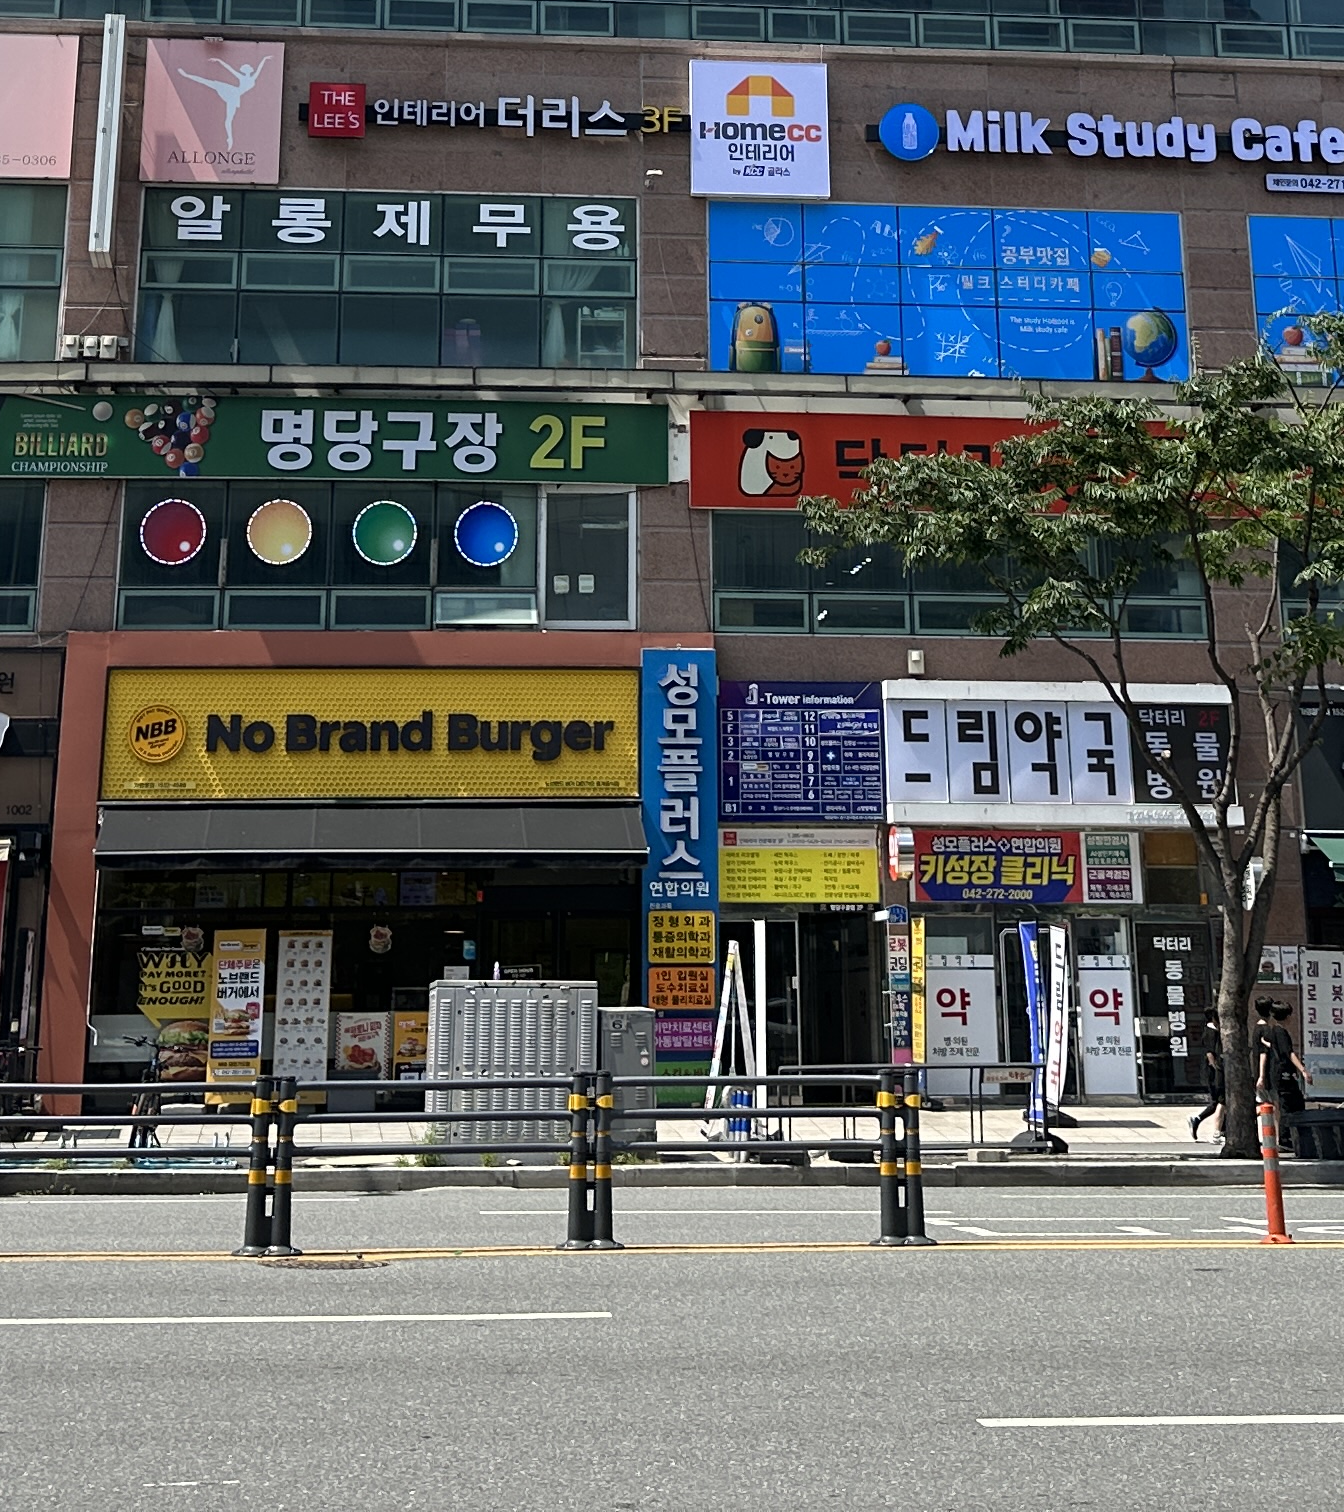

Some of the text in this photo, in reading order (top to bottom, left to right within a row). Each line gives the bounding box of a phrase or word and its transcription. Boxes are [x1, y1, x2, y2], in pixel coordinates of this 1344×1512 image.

[320, 90, 356, 106] THE
[314, 111, 361, 130] LEE'S
[374, 94, 683, 138] 인테리어 더리스 3F
[946, 109, 1052, 155] Milk
[1066, 112, 1217, 163] Study
[167, 149, 256, 167] ALLONGE
[728, 142, 795, 163] 인테리어
[1000, 245, 1071, 266] 공부맛집
[14, 431, 109, 457] BILLIARD
[260, 408, 607, 474] 명당구장 2F
[11, 461, 109, 473] CHAMPIONSHIP
[1138, 708, 1186, 728] 닥터리
[135, 710, 615, 762] NBB No Brand Burger
[902, 709, 1117, 796] 드림약국
[657, 662, 704, 880] 성모플러스
[6, 803, 33, 816] 1002
[931, 836, 1062, 854] 성모플러스 연합의원
[920, 855, 997, 885] 키성장
[1001, 855, 1076, 887] 클리닉
[649, 881, 710, 898] 연합의원
[962, 888, 1034, 900] 042-272-2000
[652, 915, 711, 928] 정형외과
[1153, 936, 1192, 951] 닥터리
[137, 952, 209, 969] WHY
[652, 946, 711, 959] 재활의학과
[889, 957, 908, 973] 코딩
[141, 970, 206, 979] PAY MORE?
[218, 972, 260, 985] 노브랜드
[676, 970, 709, 982] 입원실
[159, 980, 206, 994] GOOD
[216, 986, 260, 999] 버거에서
[655, 982, 709, 994] 도수치료실
[137, 996, 206, 1006] ENOUGH!
[936, 988, 971, 1026] 약
[1089, 988, 1123, 1026] 약
